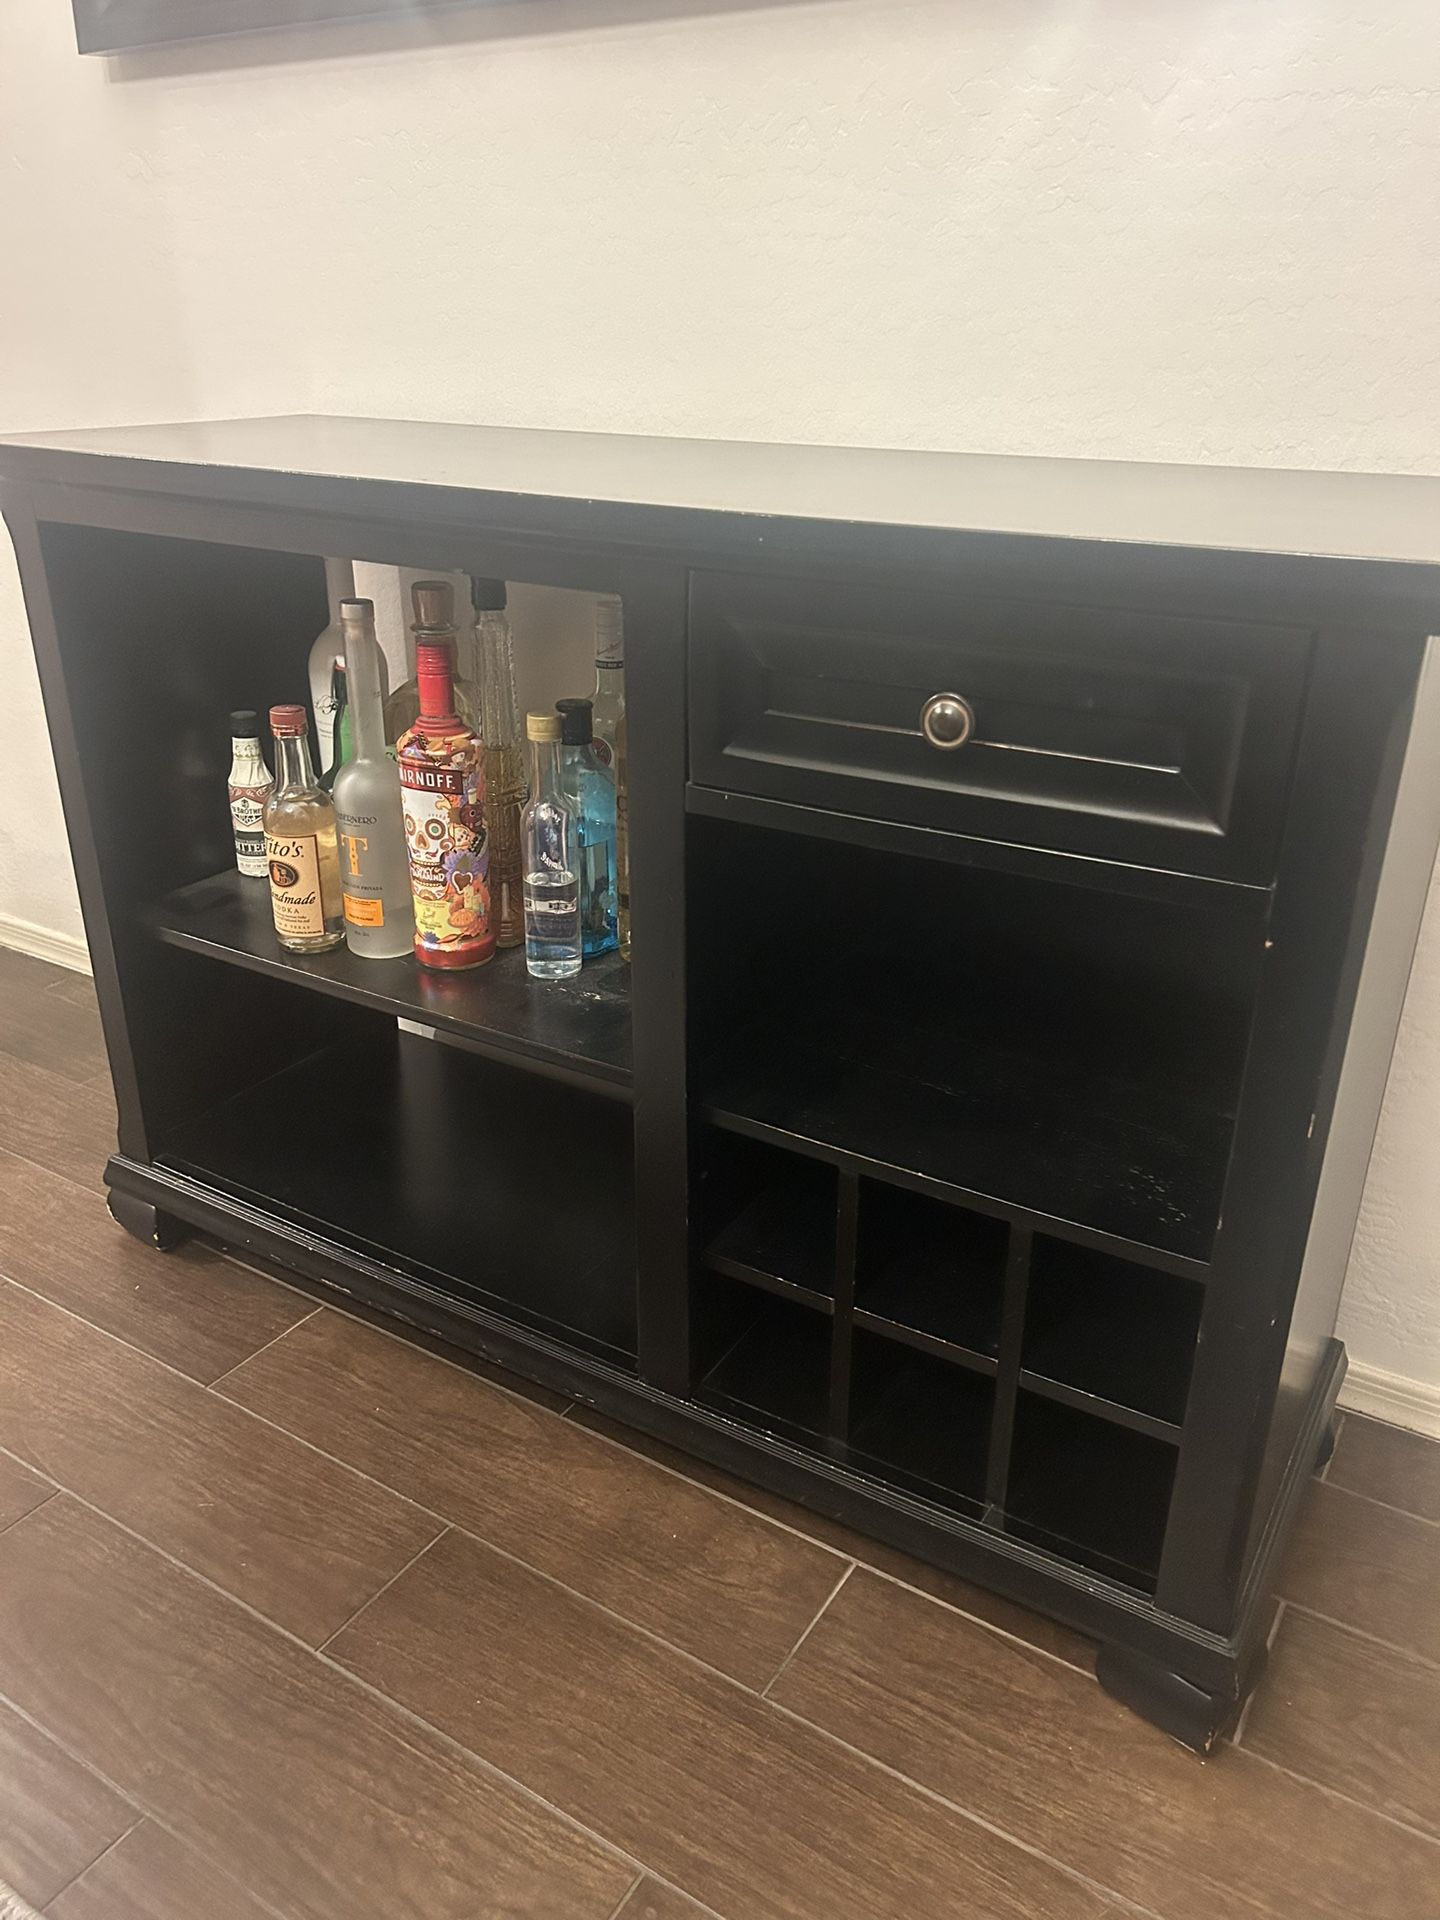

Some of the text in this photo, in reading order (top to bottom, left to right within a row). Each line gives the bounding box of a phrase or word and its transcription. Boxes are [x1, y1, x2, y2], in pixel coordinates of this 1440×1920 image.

[399, 767, 456, 789] IRNOFF.
[236, 842, 267, 852] ITTER
[271, 891, 316, 905] ndmade
